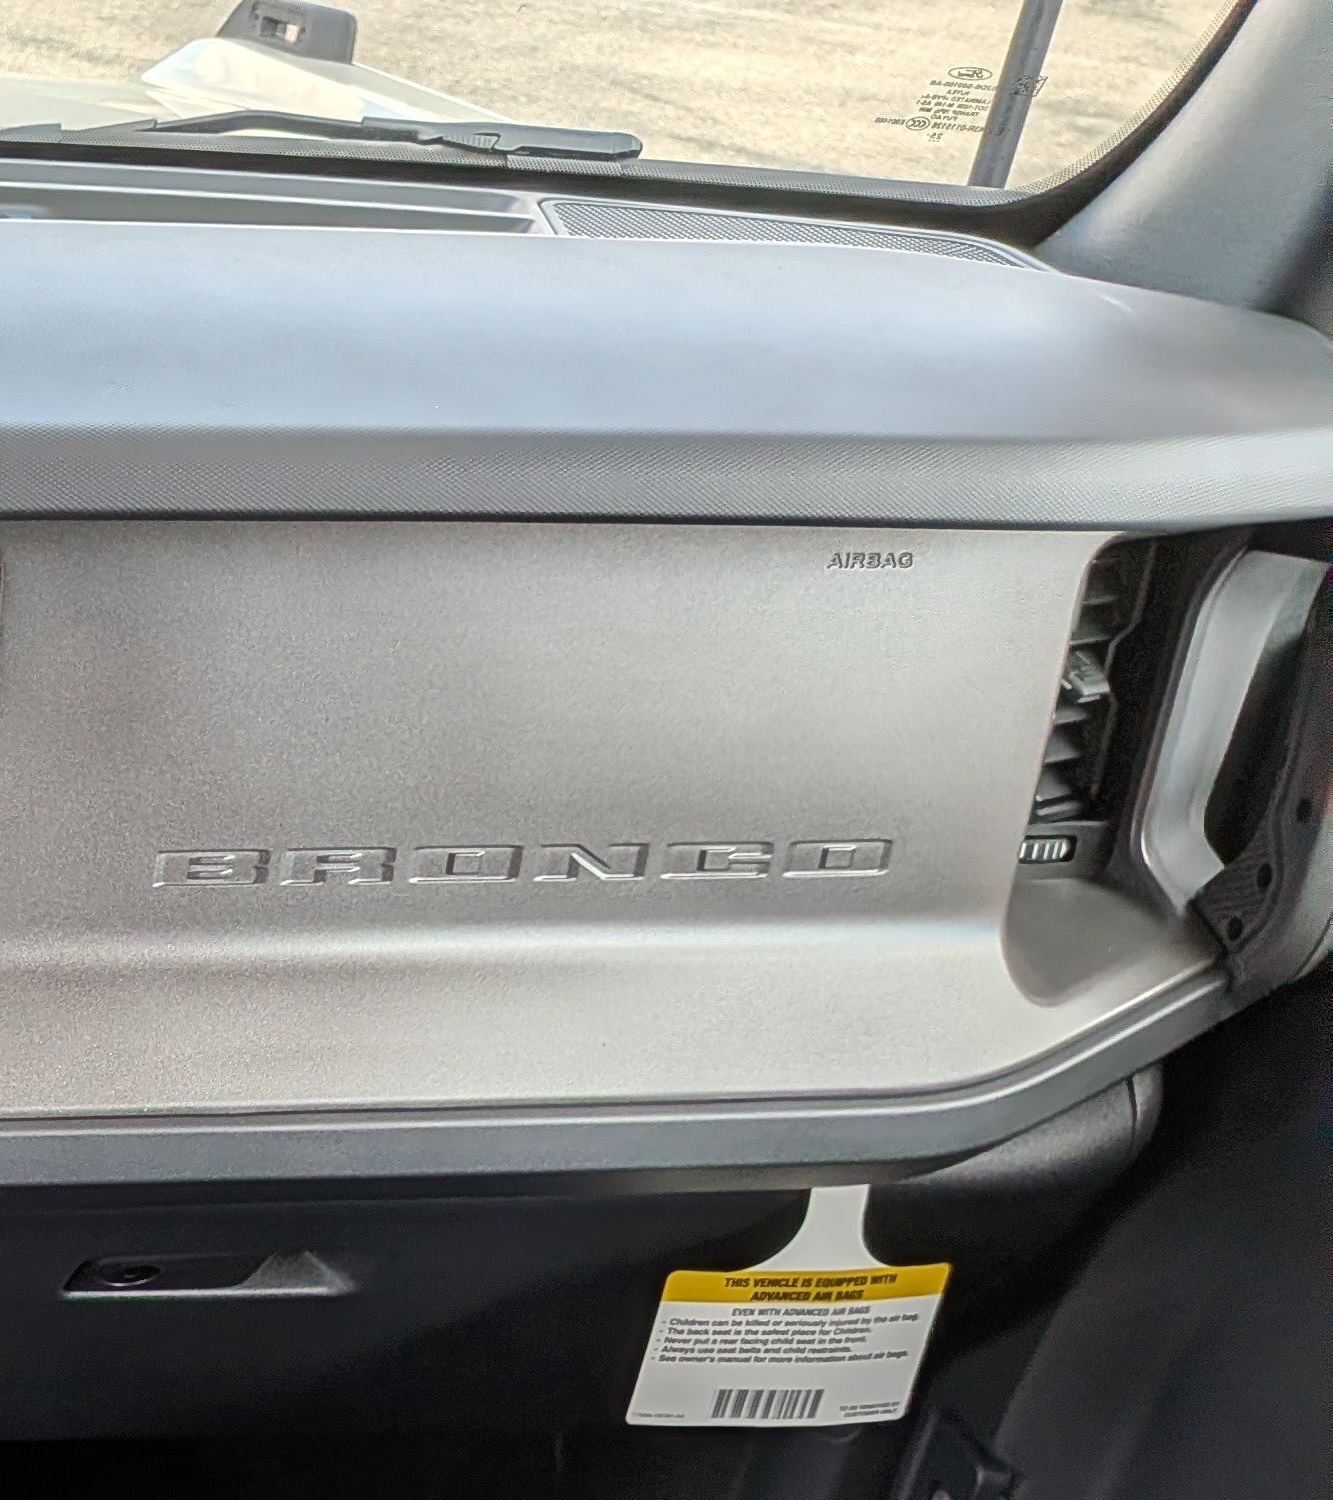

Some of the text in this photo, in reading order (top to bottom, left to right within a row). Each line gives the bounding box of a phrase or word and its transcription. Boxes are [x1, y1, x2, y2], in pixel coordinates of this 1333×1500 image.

[827, 551, 914, 570] AIRBAG
[152, 838, 894, 888] BRONCO
[725, 1274, 898, 1288] THIS VEHICLE IS EQUIPPED WITH
[750, 1290, 864, 1301] ADVANCED AIR BAGS
[732, 1308, 755, 1316] EVEN
[783, 1308, 829, 1316] ADVANCED
